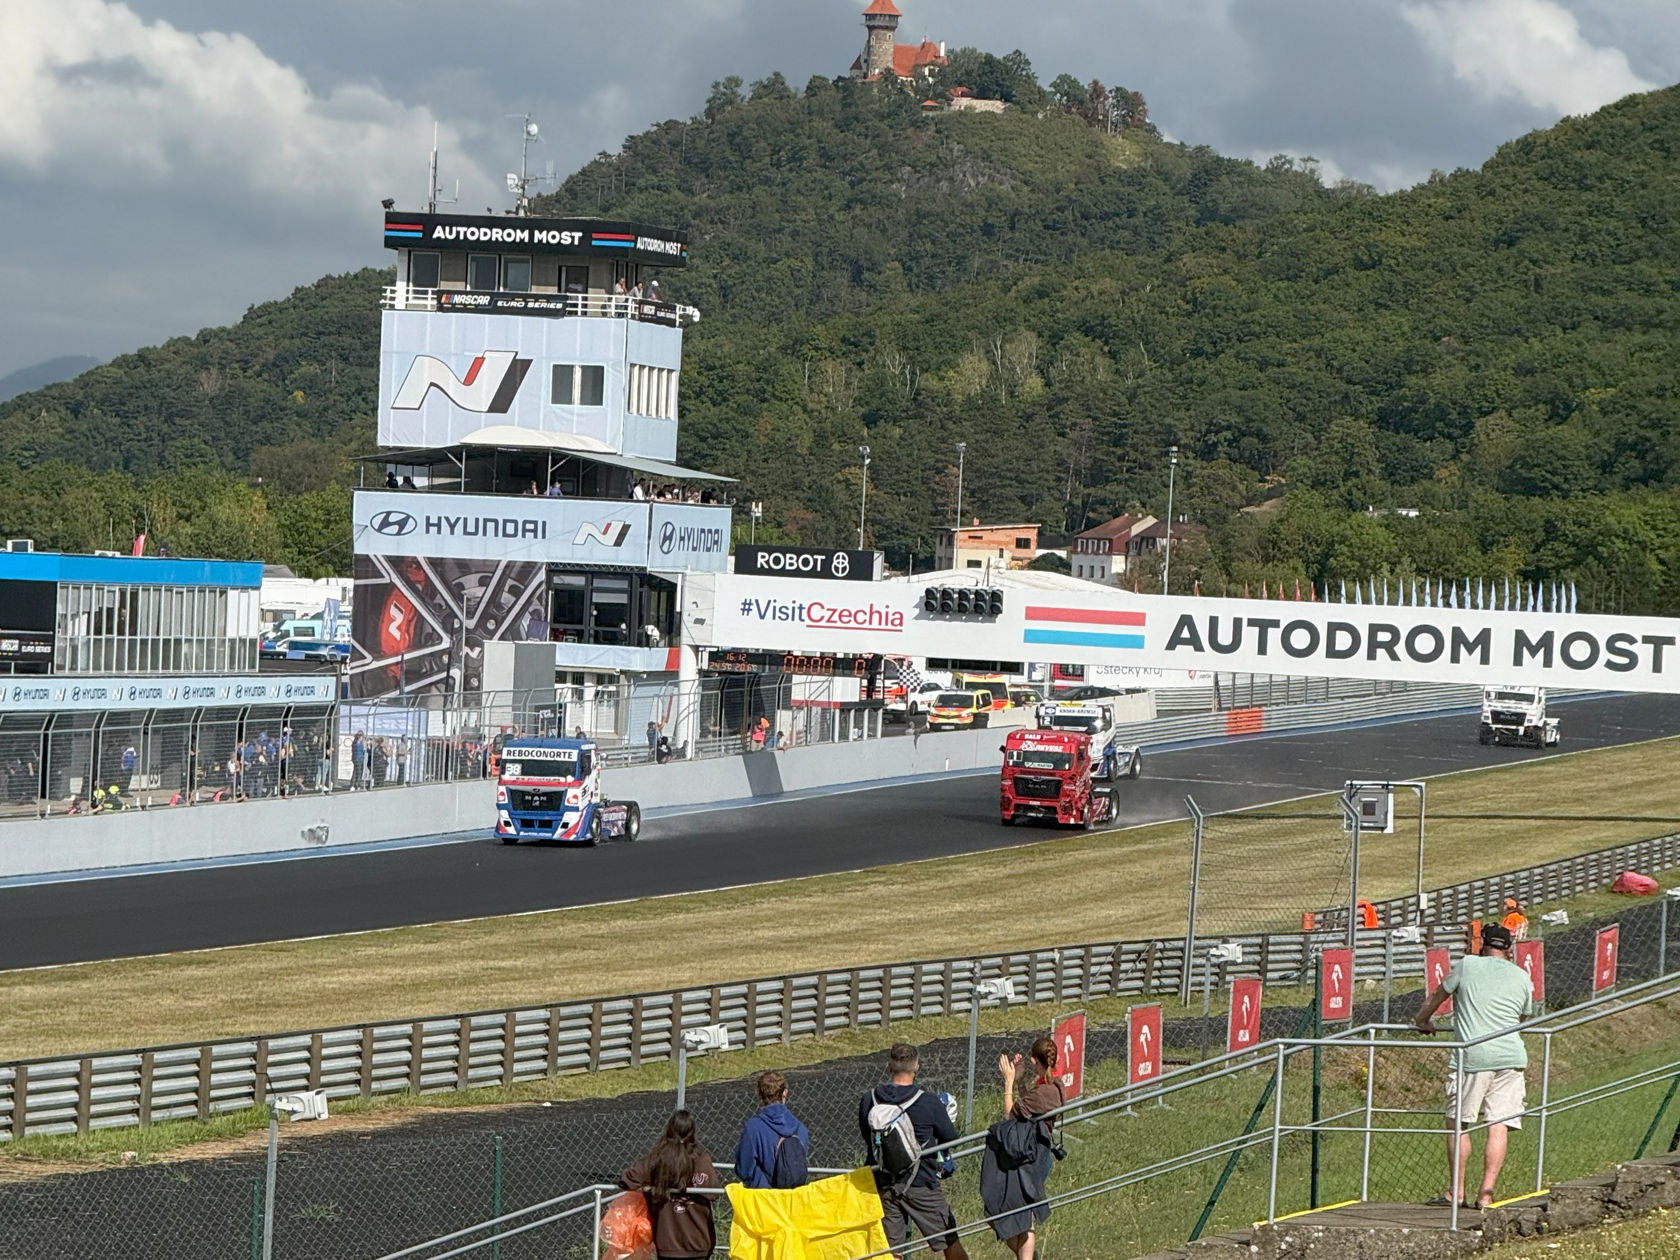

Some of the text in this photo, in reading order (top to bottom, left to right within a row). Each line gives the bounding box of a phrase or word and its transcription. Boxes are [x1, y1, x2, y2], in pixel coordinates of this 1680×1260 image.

[432, 225, 583, 246] AUTODROM MOST
[637, 236, 682, 256] AUTODROM MOST
[452, 294, 491, 306] NASCAR
[425, 515, 547, 540] HYUNDAI
[679, 526, 723, 553] HYUNDAI
[757, 551, 826, 572] ROBOT
[740, 598, 904, 627] #VisitCzechia
[1165, 613, 1677, 675] AUTODROM MOST
[23, 688, 50, 699] HYUNDAI
[82, 688, 108, 699] HYUNDAI
[138, 688, 163, 699] HYUNDAI
[192, 687, 216, 697] HYUNDAI
[244, 686, 267, 696] HYUNDAI
[293, 686, 315, 696] HYUNDAI
[506, 749, 574, 760] REBOCONORTE
[506, 764, 521, 775] 38
